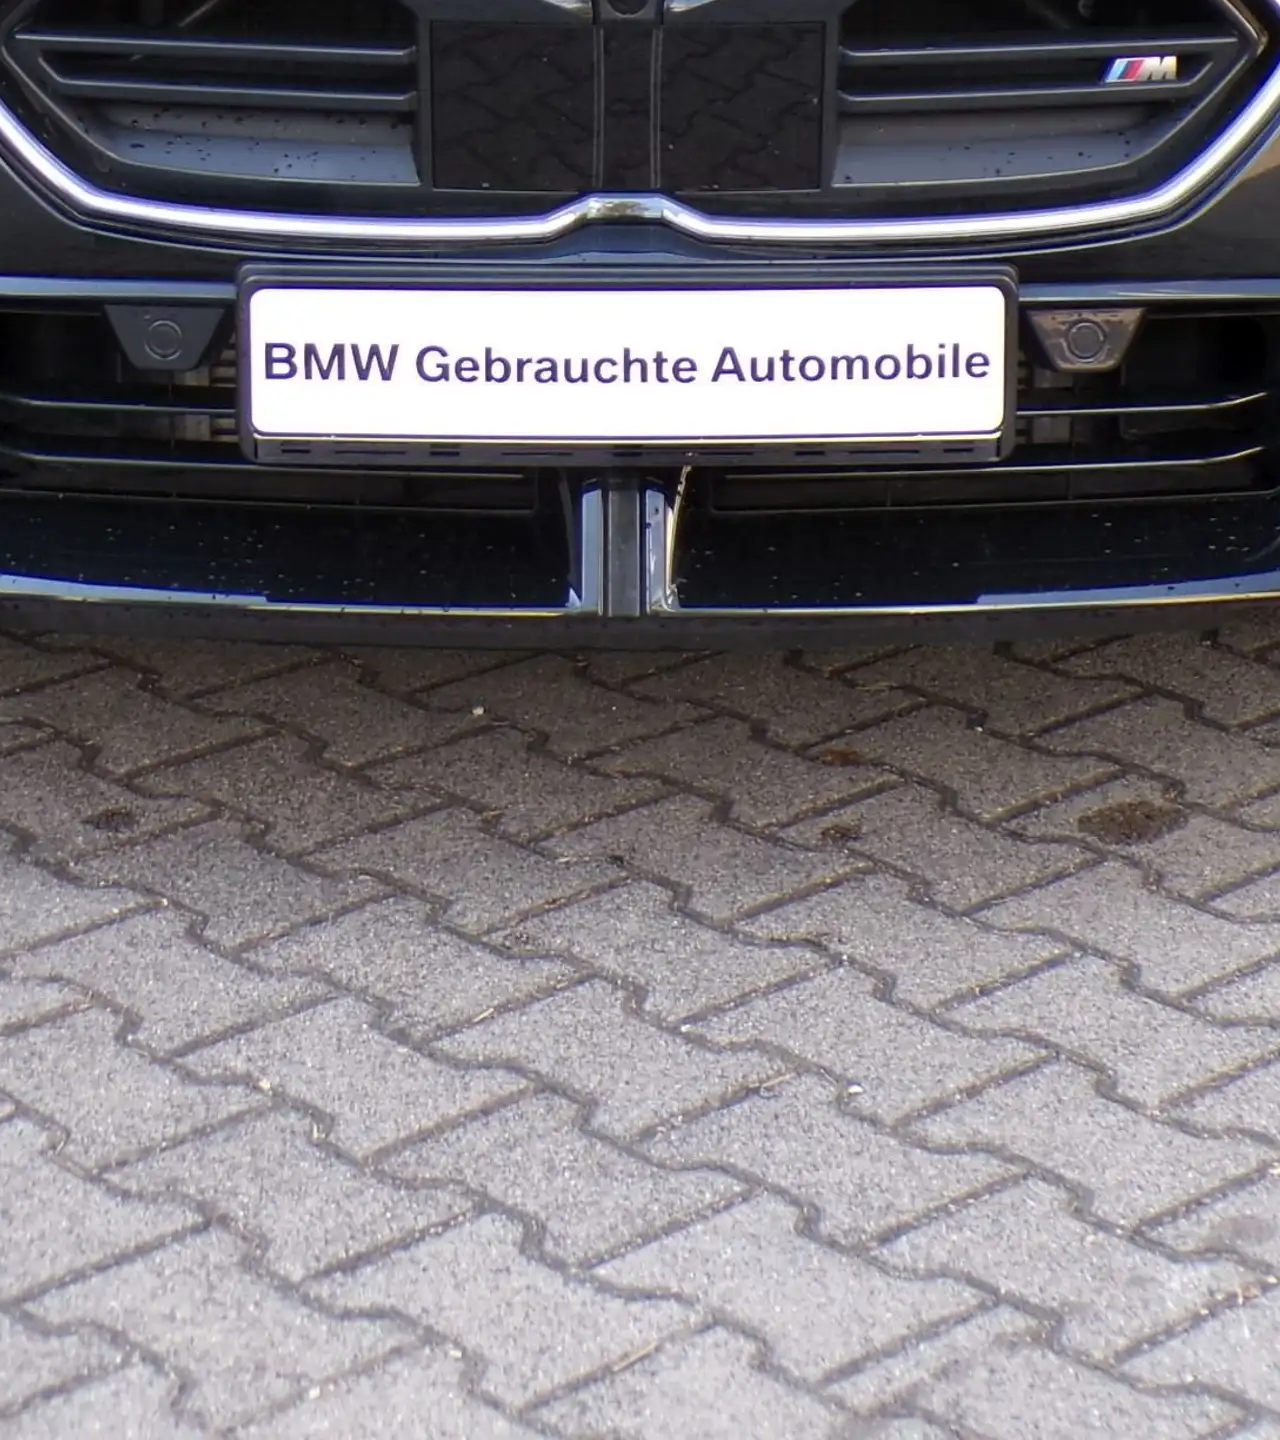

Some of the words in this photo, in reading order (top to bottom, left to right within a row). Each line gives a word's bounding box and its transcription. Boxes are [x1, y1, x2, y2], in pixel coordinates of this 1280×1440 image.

[264, 343, 399, 381] BMW
[416, 345, 697, 383] Gebrauchte
[712, 343, 990, 382] Automobile
